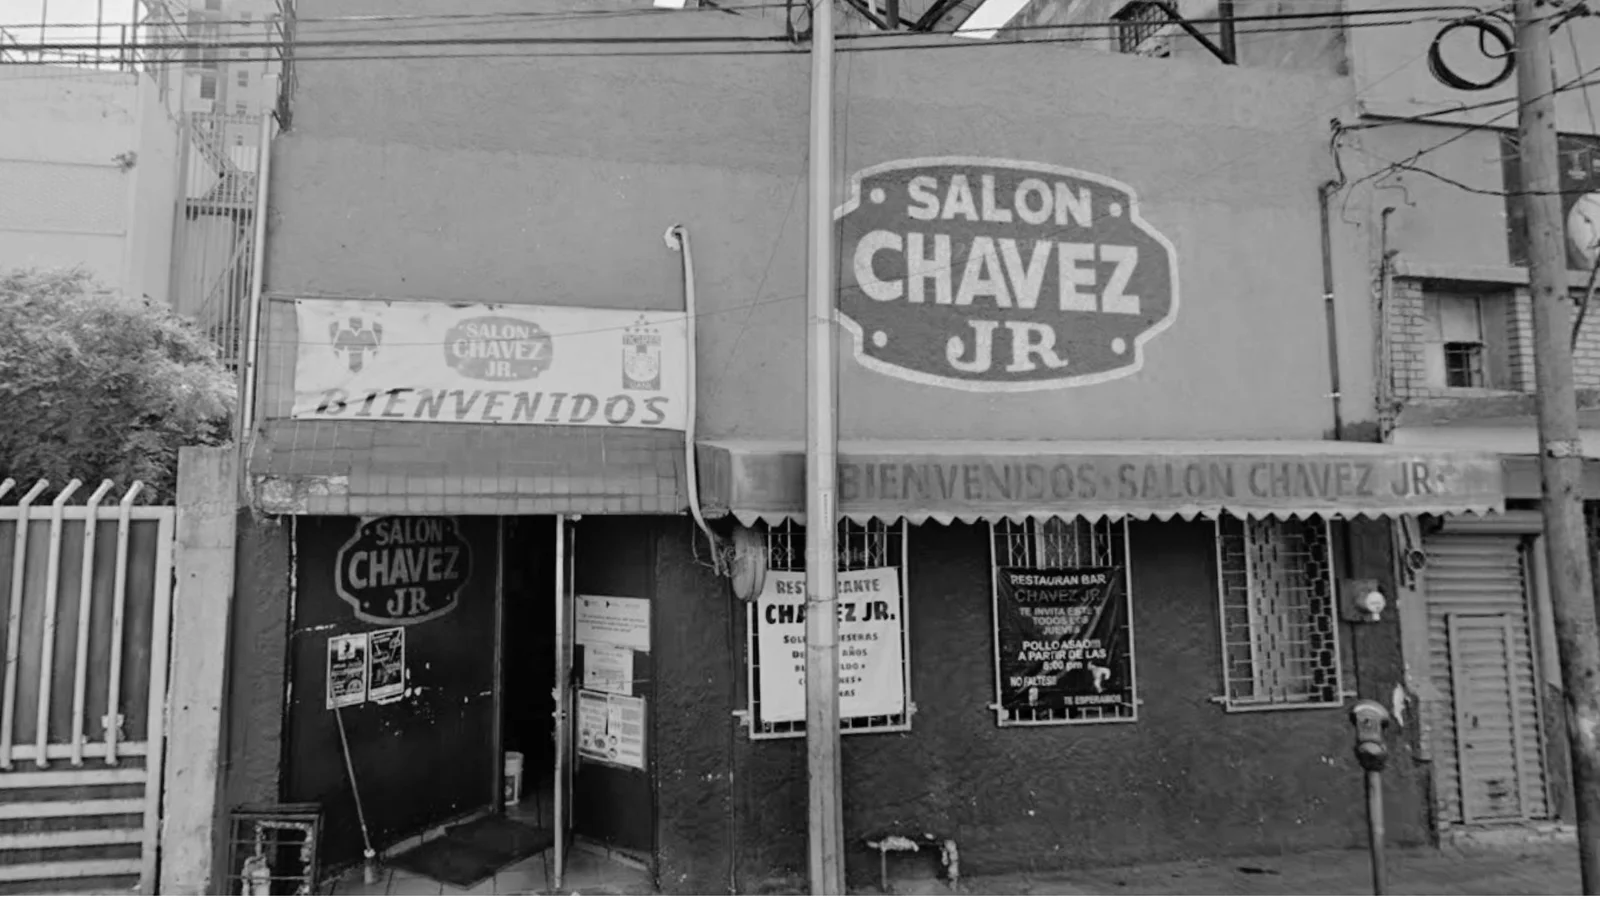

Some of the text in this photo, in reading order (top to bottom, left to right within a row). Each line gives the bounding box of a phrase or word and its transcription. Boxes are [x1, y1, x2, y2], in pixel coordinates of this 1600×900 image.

[907, 174, 1093, 228] SALON
[853, 230, 1141, 315] CHAVEZ
[465, 323, 529, 340] SALON
[451, 338, 544, 361] CHAVEZ
[946, 320, 1069, 373] JR
[484, 361, 517, 378] JR.
[315, 388, 670, 425] BIENVENIDOS
[838, 462, 1097, 501] BIENVENIDOS
[1117, 461, 1235, 499] SALON
[1247, 461, 1374, 498] CHAVEZ
[375, 516, 443, 546] SALON
[348, 545, 460, 590] CHAVEZ
[1010, 573, 1107, 585] RESTAURAN BAR
[386, 587, 430, 616] JR
[1014, 589, 1078, 602] CHAVEZ
[862, 600, 896, 623] JR.
[1034, 606, 1066, 616] INVITA
[1017, 648, 1107, 662] A PARTIR DE LAS
[1022, 640, 1061, 651] POLLO
[1065, 661, 1083, 673] pm
[1010, 676, 1023, 687] NO
